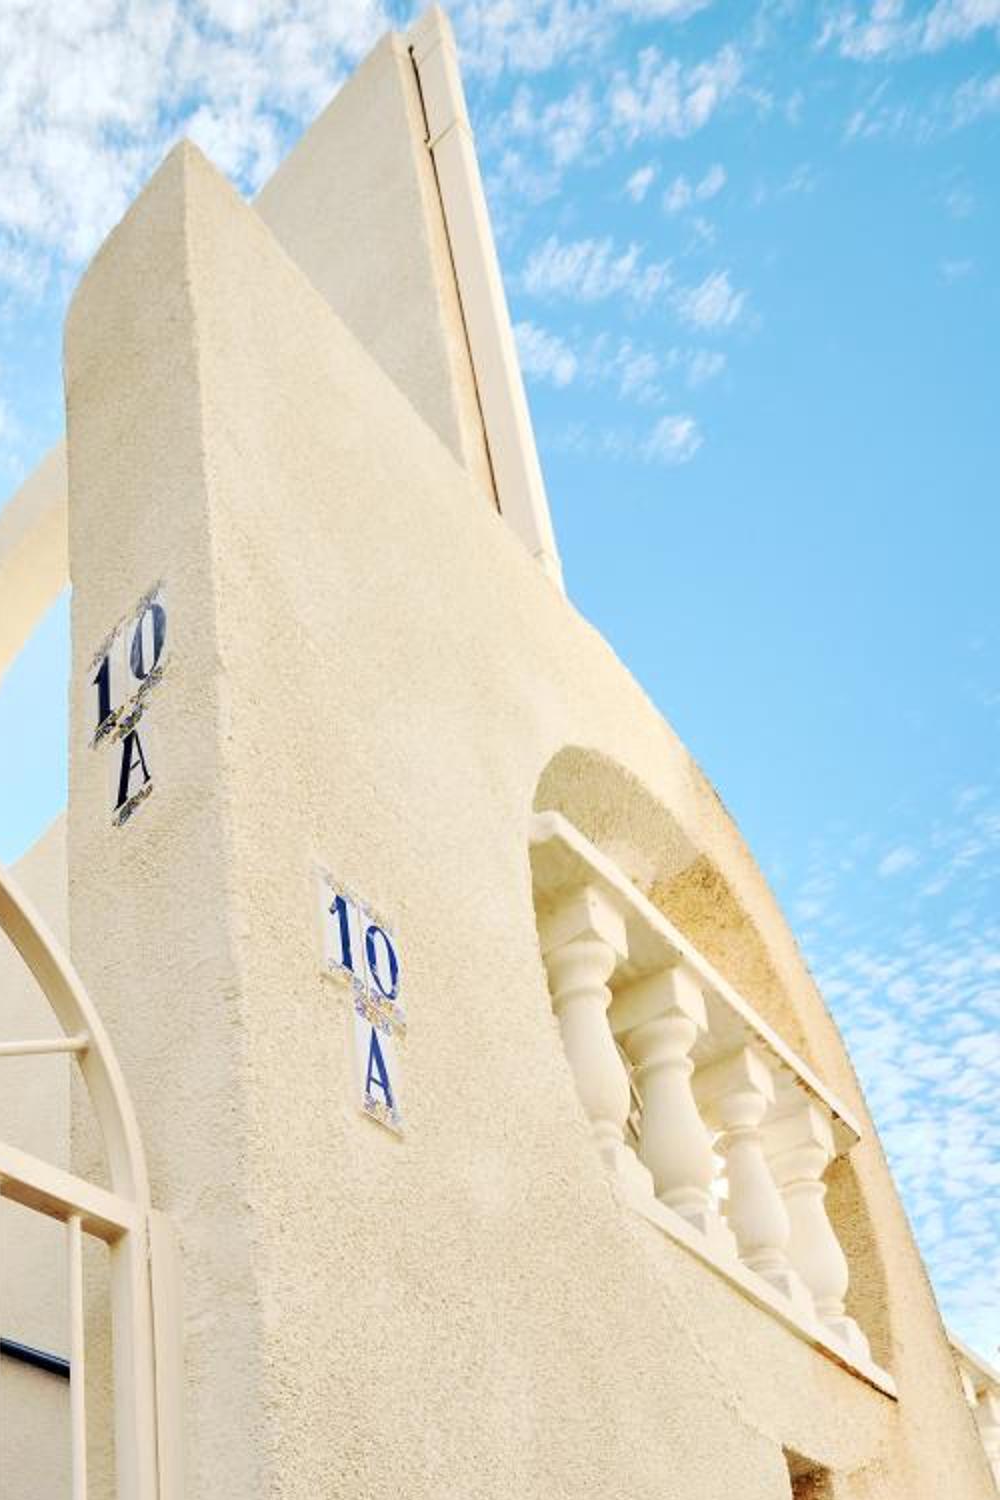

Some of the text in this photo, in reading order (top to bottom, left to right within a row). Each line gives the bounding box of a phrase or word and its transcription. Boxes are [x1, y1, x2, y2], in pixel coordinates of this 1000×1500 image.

[93, 603, 167, 728] 10
[114, 730, 151, 809] A
[329, 895, 399, 1001] 10
[365, 1027, 393, 1108] A
